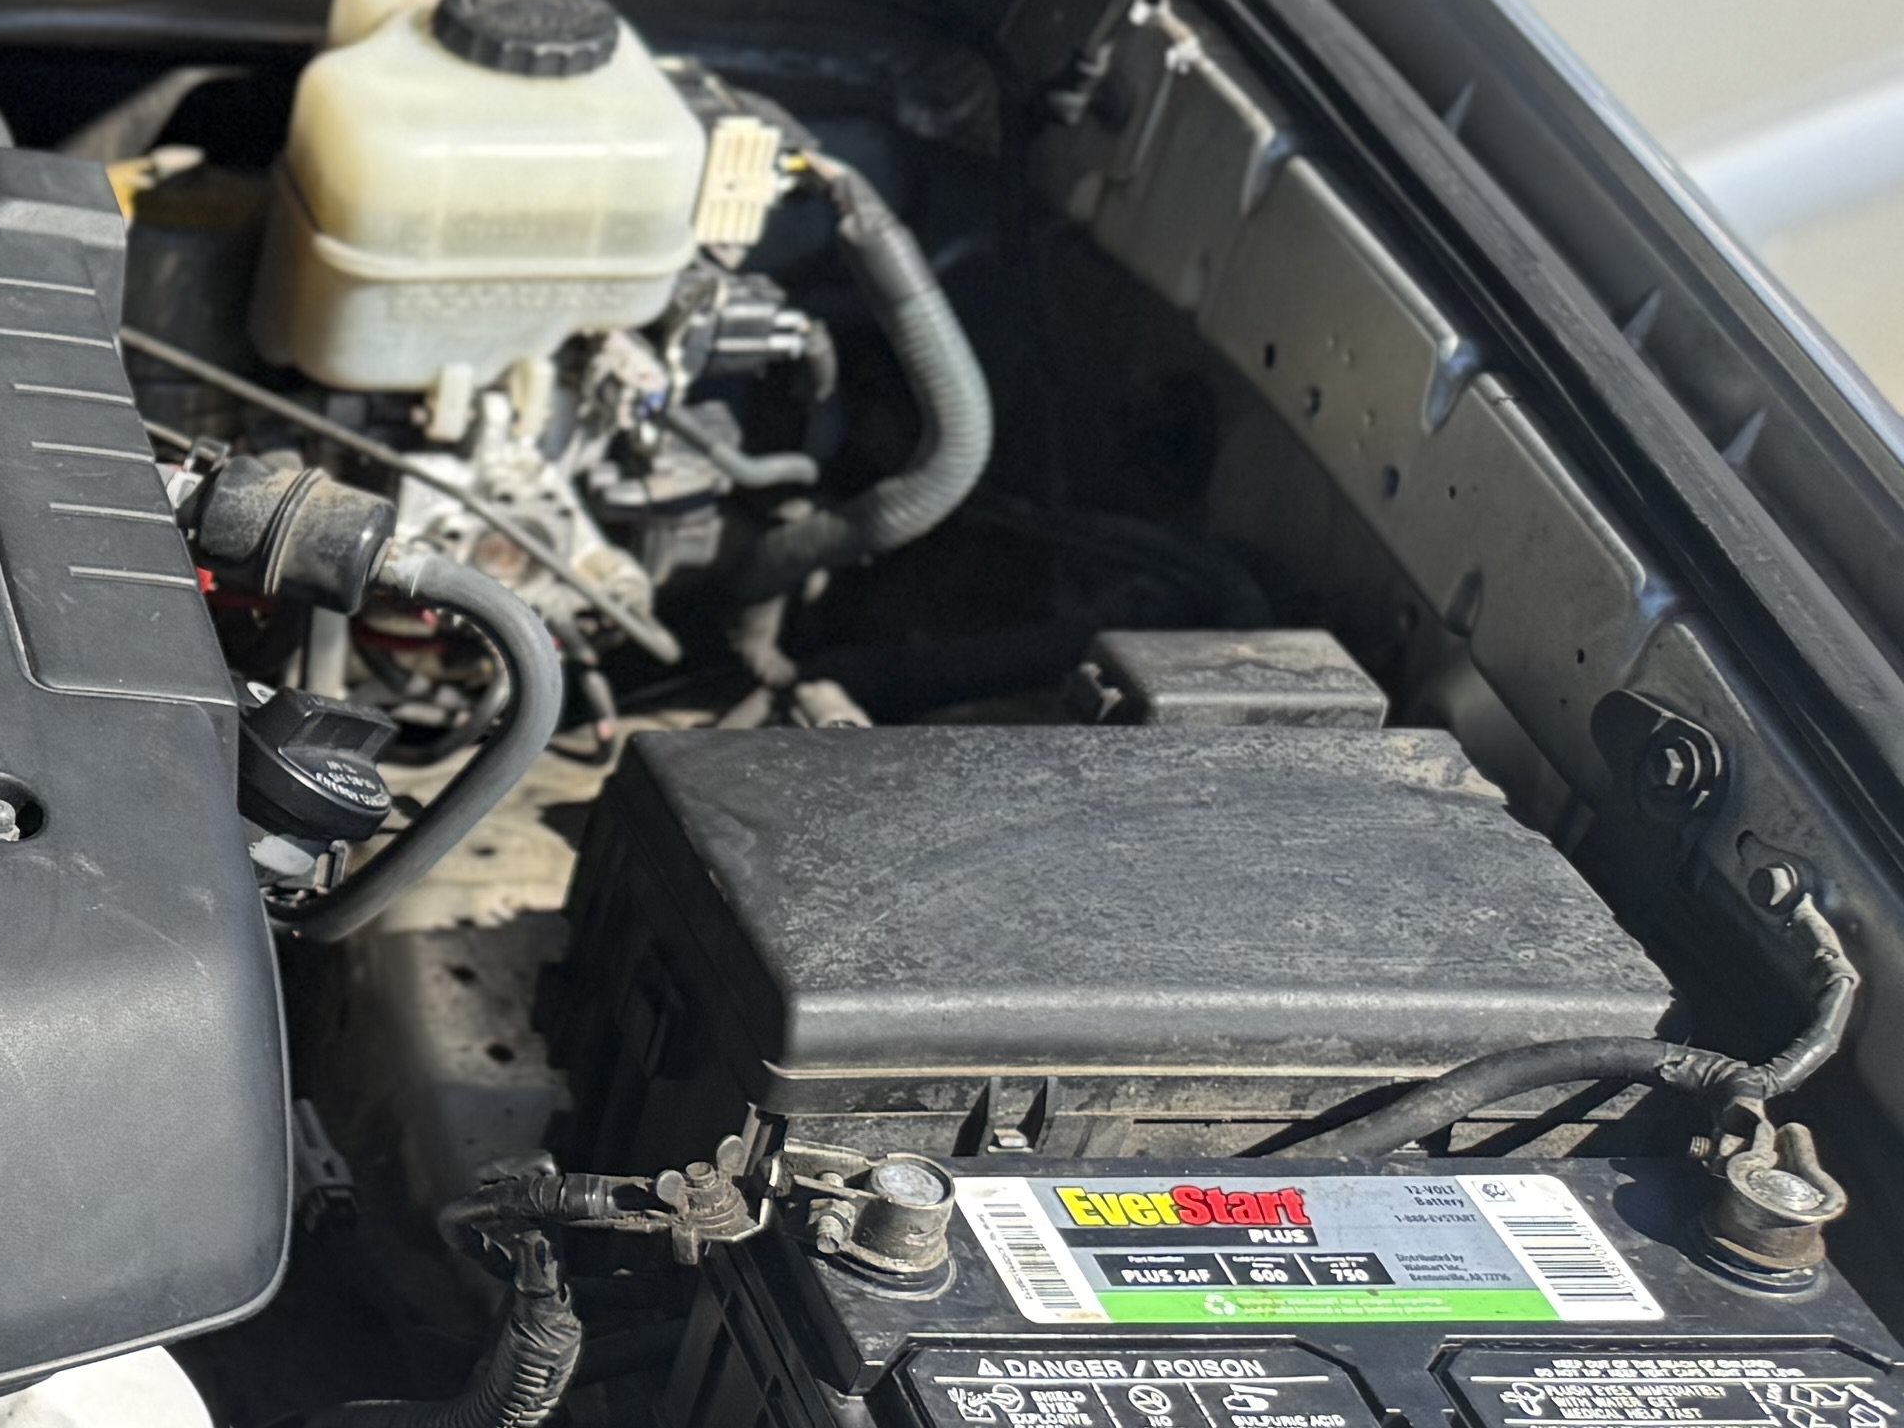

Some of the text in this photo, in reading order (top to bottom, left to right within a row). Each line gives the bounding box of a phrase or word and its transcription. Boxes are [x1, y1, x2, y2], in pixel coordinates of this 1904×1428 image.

[1404, 1185, 1455, 1195] 12-VOLT
[1054, 1185, 1312, 1227] EverStart
[1414, 1197, 1464, 1208] Battery
[1248, 1228, 1310, 1244] PLUS
[1121, 1268, 1210, 1283] PLUS 24F
[1249, 1269, 1289, 1283] 600
[1330, 1269, 1369, 1283] 750
[1004, 1359, 1128, 1378] DANGER
[1153, 1359, 1267, 1378] POISON
[1030, 1390, 1087, 1403] SHIELD
[1543, 1385, 1727, 1397] FLUSH EYES IMMEDIATELY
[1551, 1397, 1592, 1408] WITH
[1647, 1397, 1678, 1408] GET
[1007, 1413, 1093, 1425] EXPLOSIVE
[1559, 1408, 1702, 1419] MEDICAL HELP FAST
[1147, 1415, 1173, 1427] NO
[1231, 1414, 1346, 1427] SULFURIC ACID
